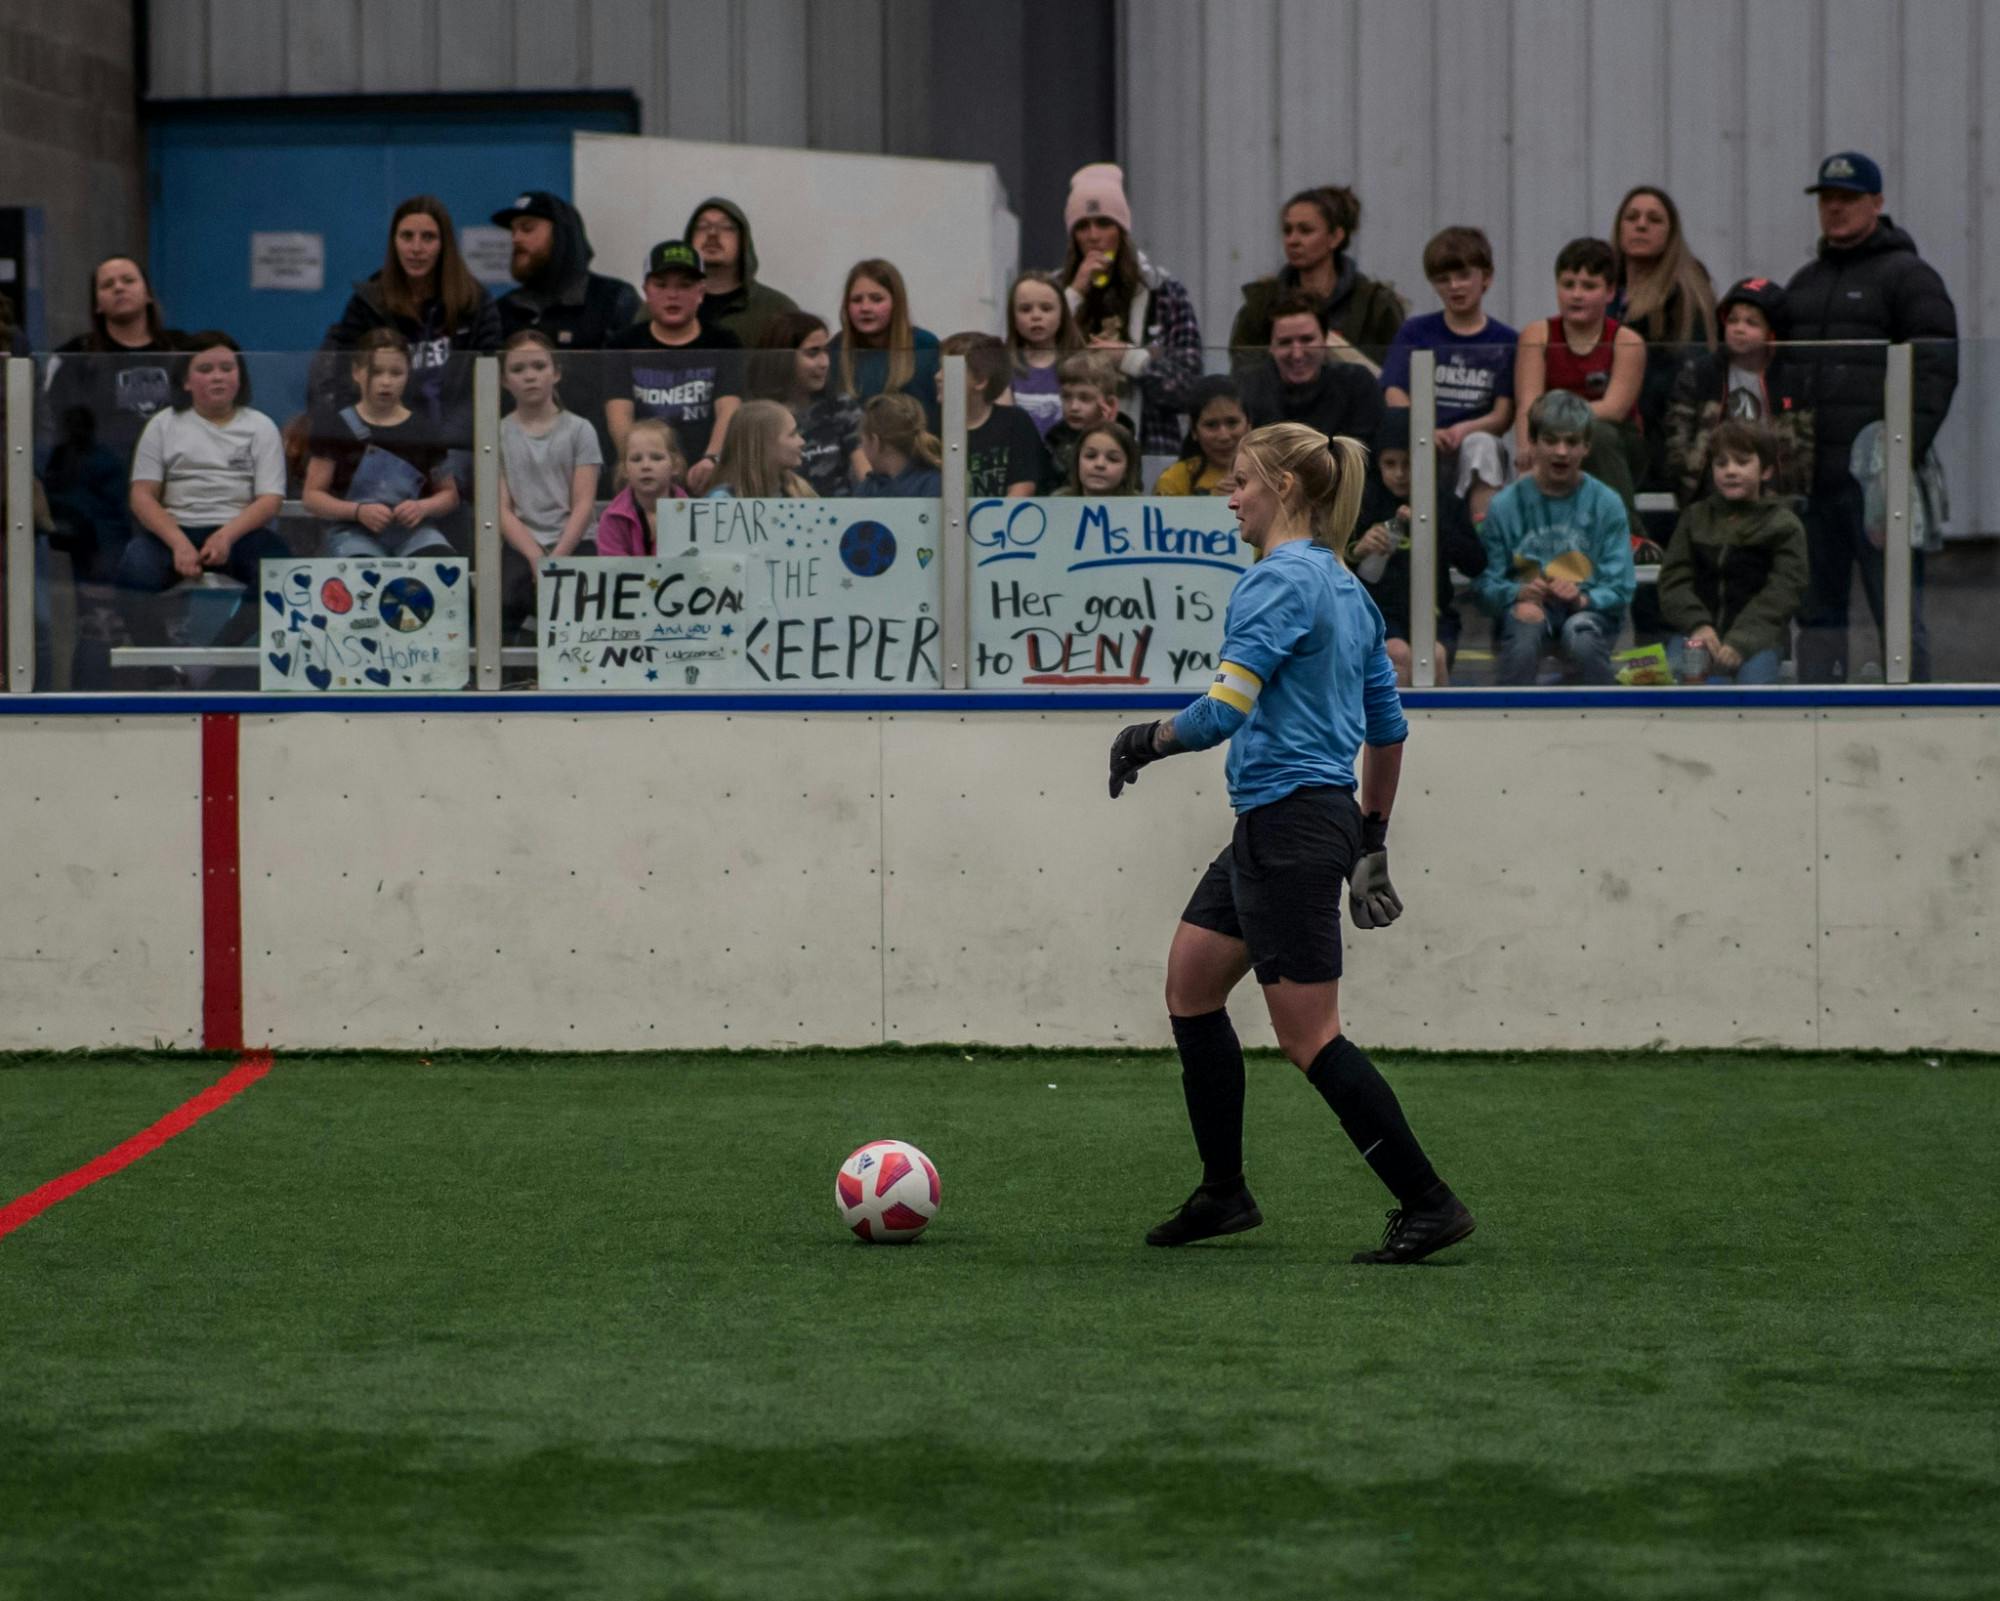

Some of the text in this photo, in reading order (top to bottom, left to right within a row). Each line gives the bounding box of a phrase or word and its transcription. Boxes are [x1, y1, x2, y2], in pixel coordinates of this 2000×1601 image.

[690, 501, 768, 544] FEAR
[967, 500, 1047, 548] GO
[542, 569, 645, 622] THE
[765, 557, 821, 600] THE
[991, 577, 1213, 633] Her goal is
[548, 626, 569, 648] is
[580, 627, 604, 642] her
[599, 646, 659, 668] NOT
[977, 643, 1013, 677] to
[1010, 625, 1153, 681] DENY
